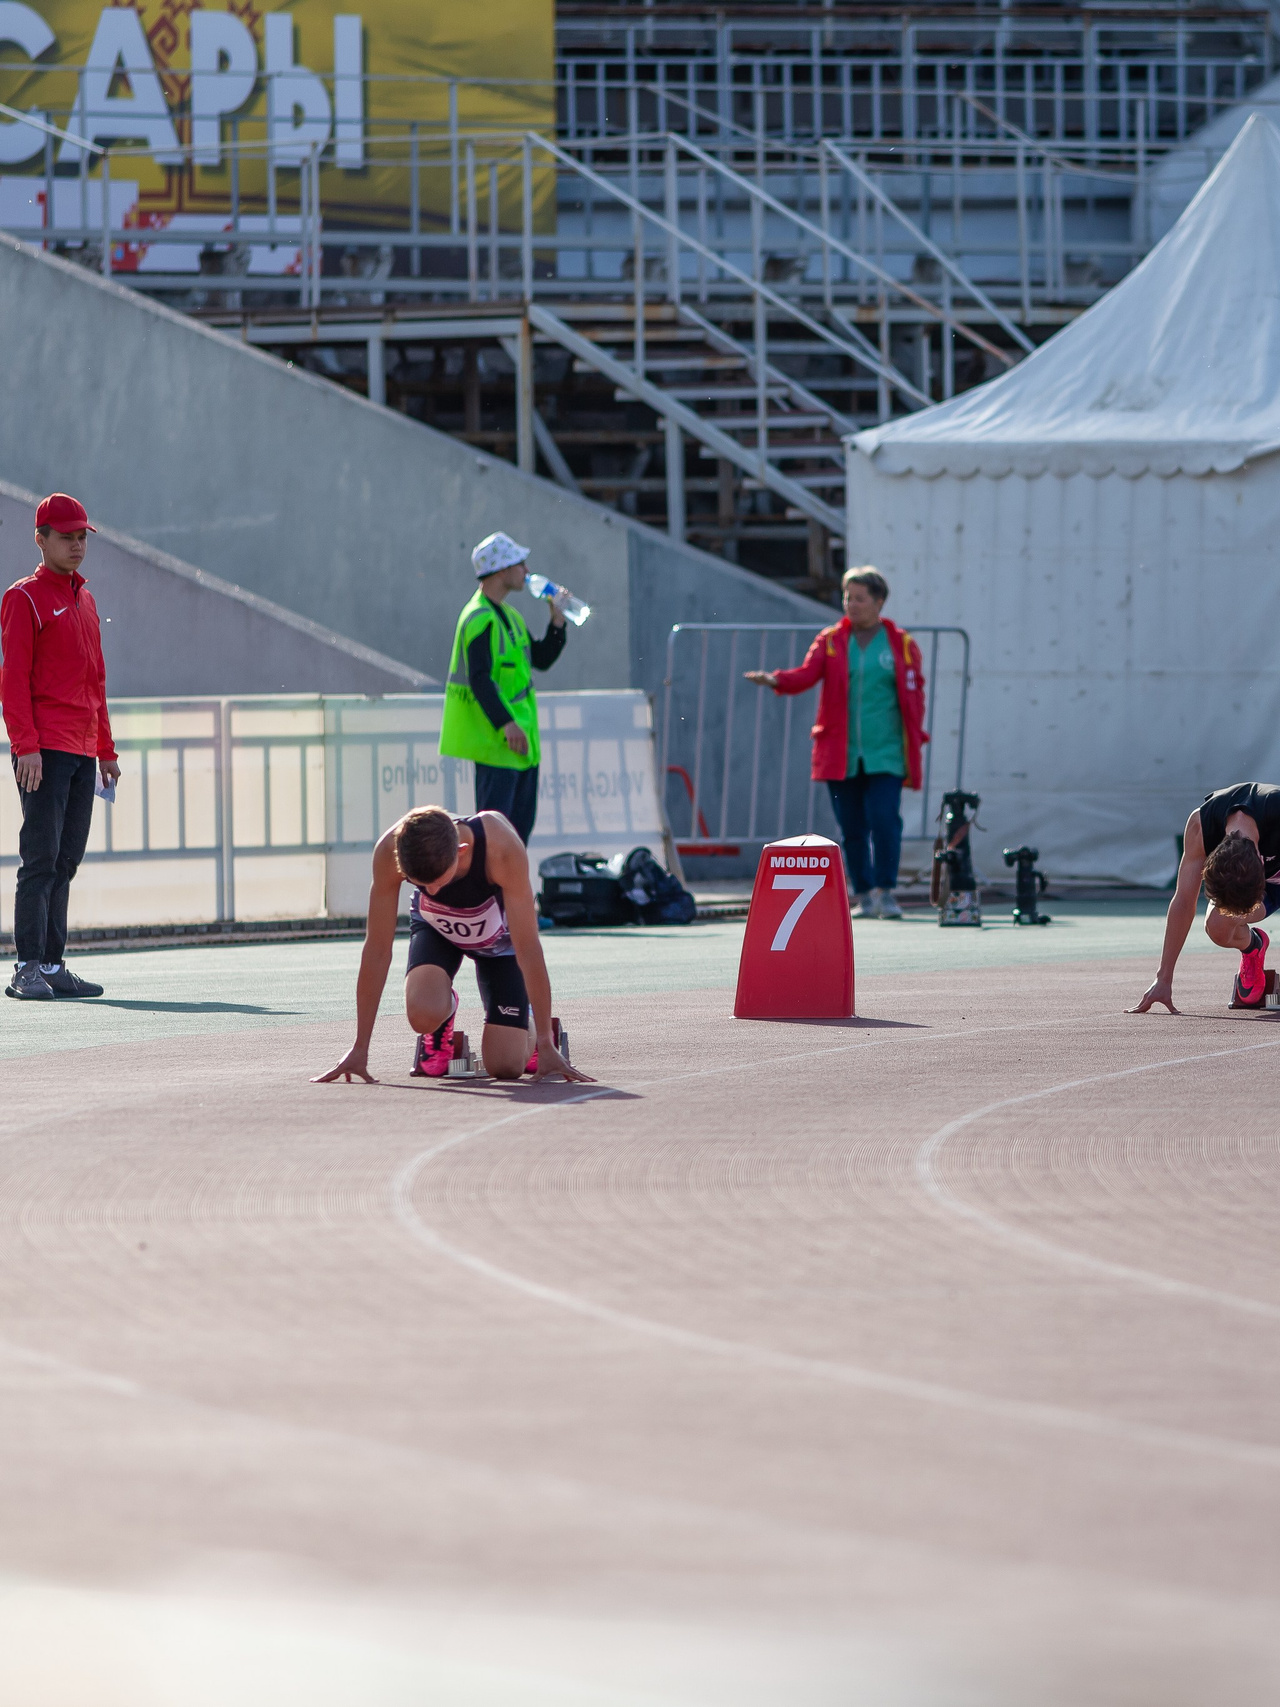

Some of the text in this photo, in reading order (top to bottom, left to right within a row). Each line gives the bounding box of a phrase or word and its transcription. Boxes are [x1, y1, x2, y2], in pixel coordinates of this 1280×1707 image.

[770, 856, 830, 868] MONDO
[770, 875, 827, 951] 7
[436, 918, 487, 938] 307
